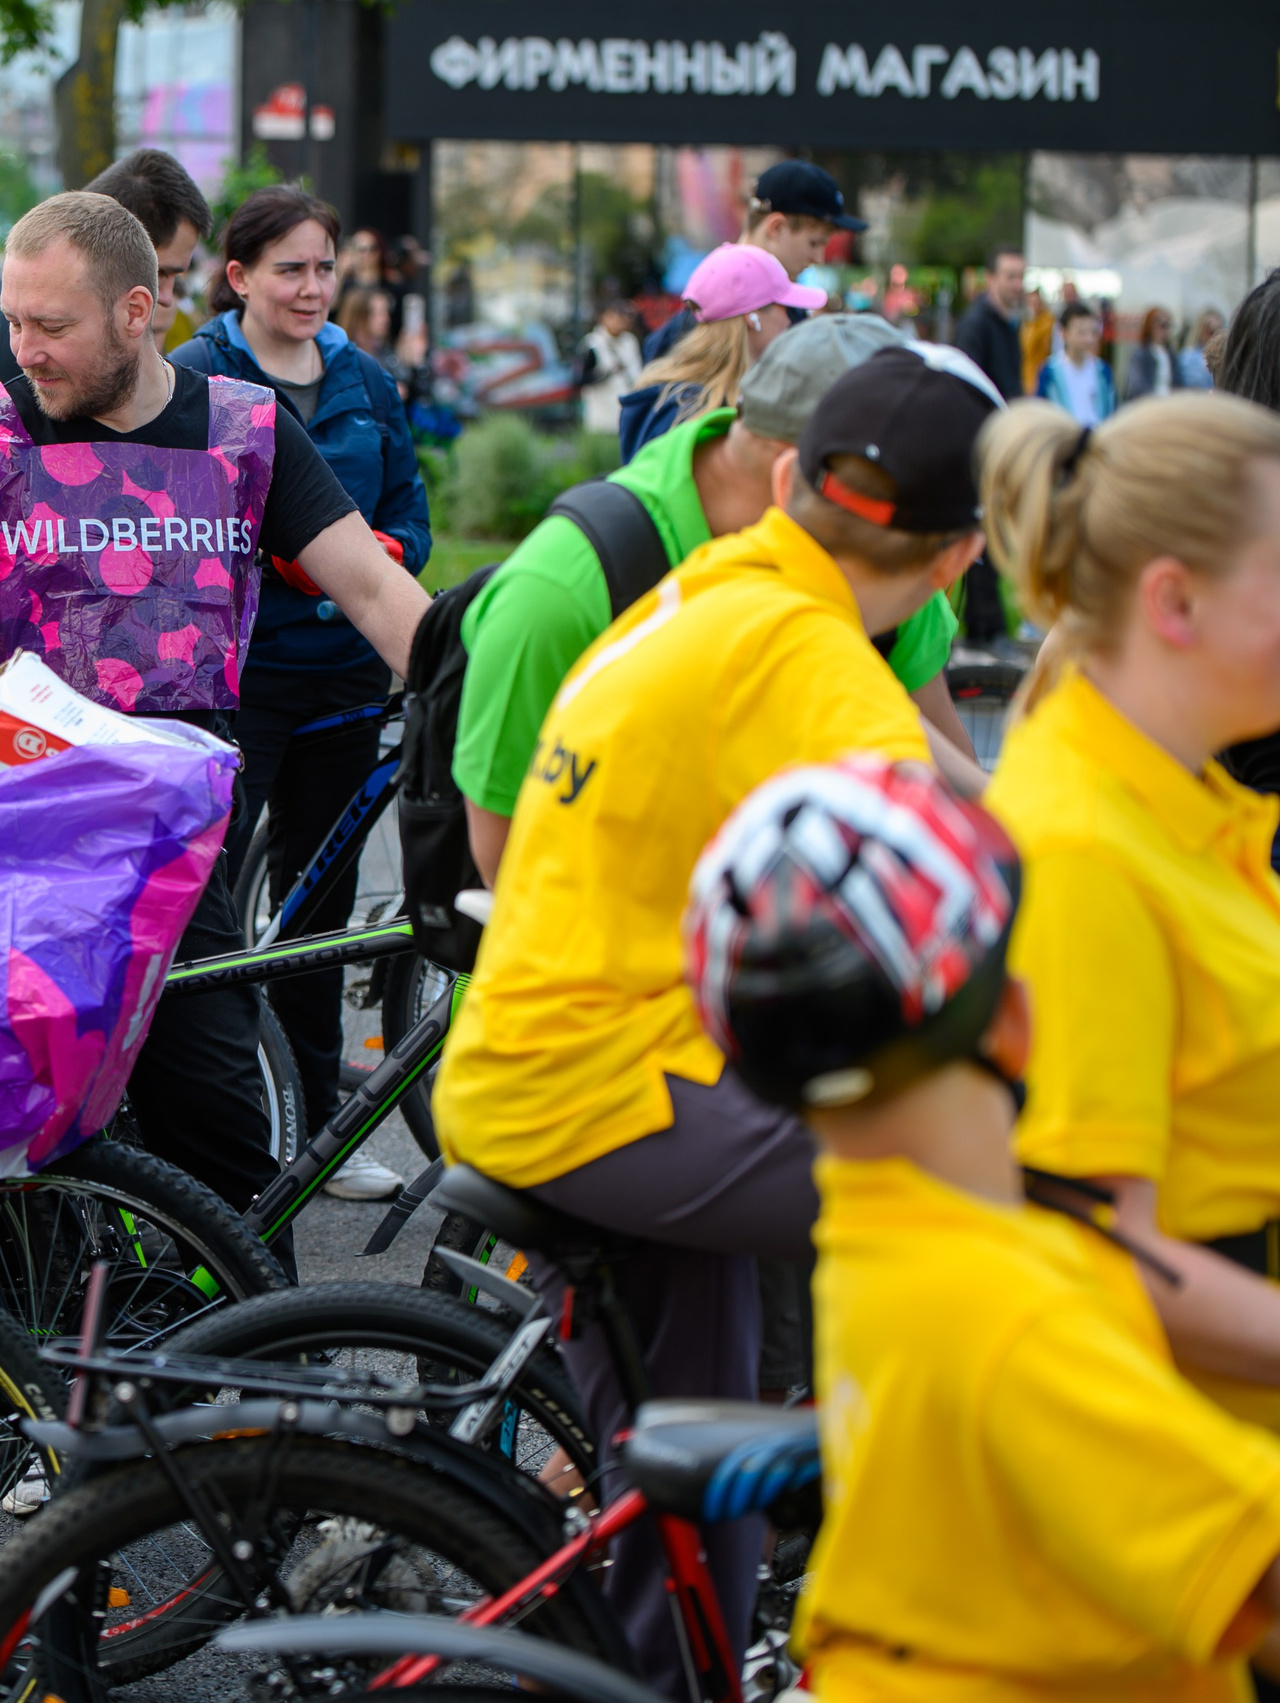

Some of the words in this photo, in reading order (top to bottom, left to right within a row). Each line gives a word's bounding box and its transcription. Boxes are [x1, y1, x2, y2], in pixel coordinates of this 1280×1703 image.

[431, 31, 797, 96] ФИРМЕННЫЙ
[817, 42, 1100, 101] МАГАЗИН
[1, 517, 253, 556] WILDBERRIES
[302, 785, 376, 891] TREK
[249, 1018, 442, 1229] STELS
[464, 1333, 533, 1432] ASECT
